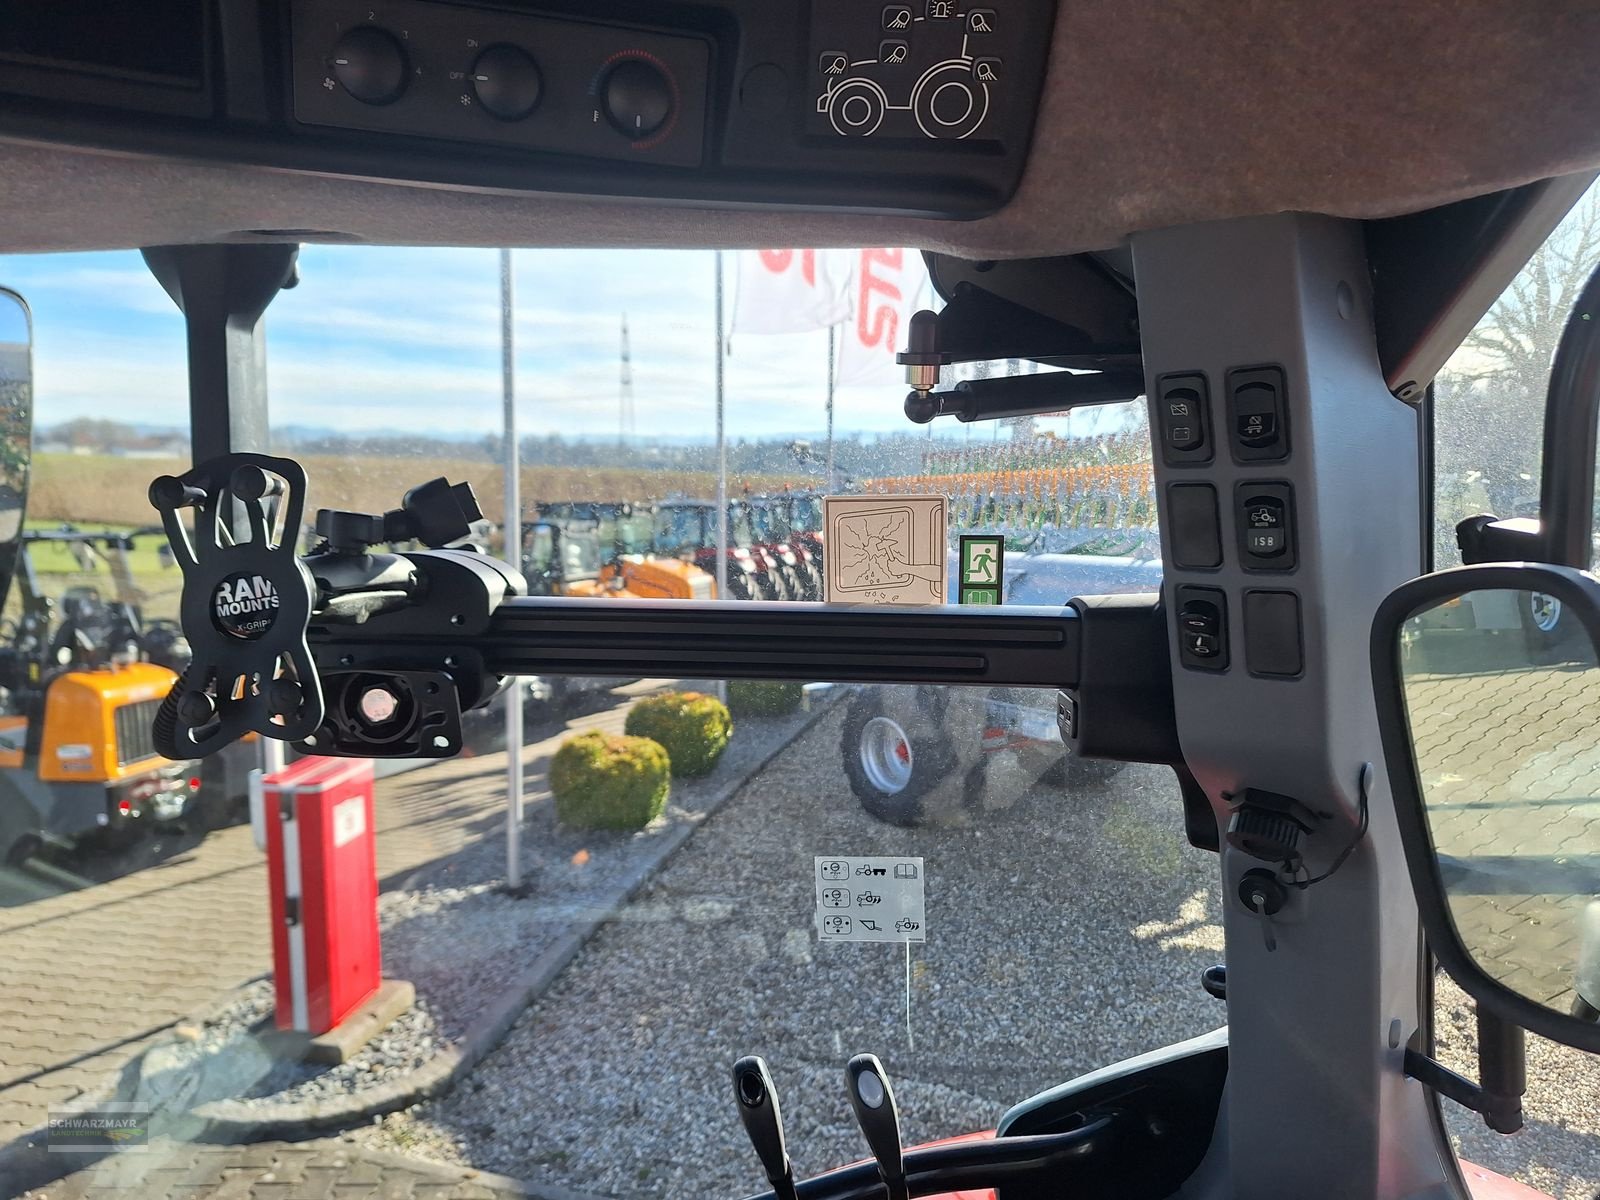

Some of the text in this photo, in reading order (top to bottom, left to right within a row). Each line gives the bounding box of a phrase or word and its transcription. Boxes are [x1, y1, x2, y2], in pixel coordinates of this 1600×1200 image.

[467, 38, 478, 47] ON
[449, 72, 464, 80] OFF
[216, 576, 277, 604] RAM
[216, 596, 279, 617] MOUNTS
